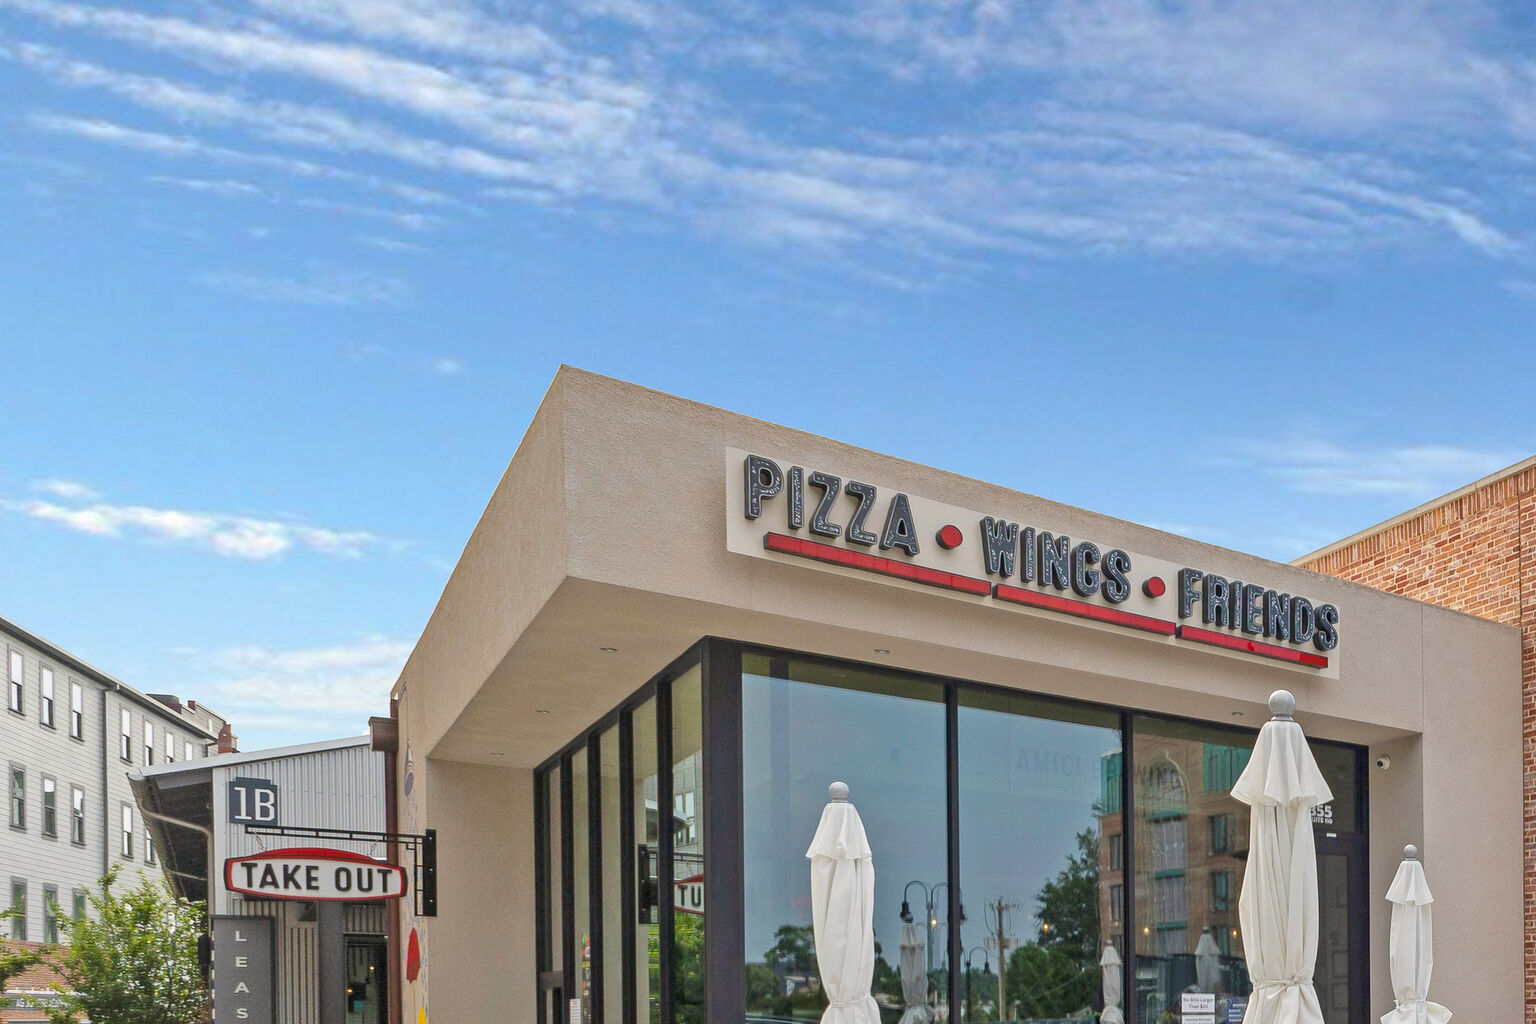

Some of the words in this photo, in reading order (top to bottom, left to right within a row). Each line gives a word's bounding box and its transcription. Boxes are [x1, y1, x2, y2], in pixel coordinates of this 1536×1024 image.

[743, 454, 921, 556] PIZZA
[979, 515, 1132, 603] WINGS
[1178, 567, 1339, 651] FRIENDS
[234, 786, 276, 822] 1B
[1311, 816, 1325, 824] UITE
[241, 862, 320, 891] TAKE
[335, 867, 393, 893] OUT
